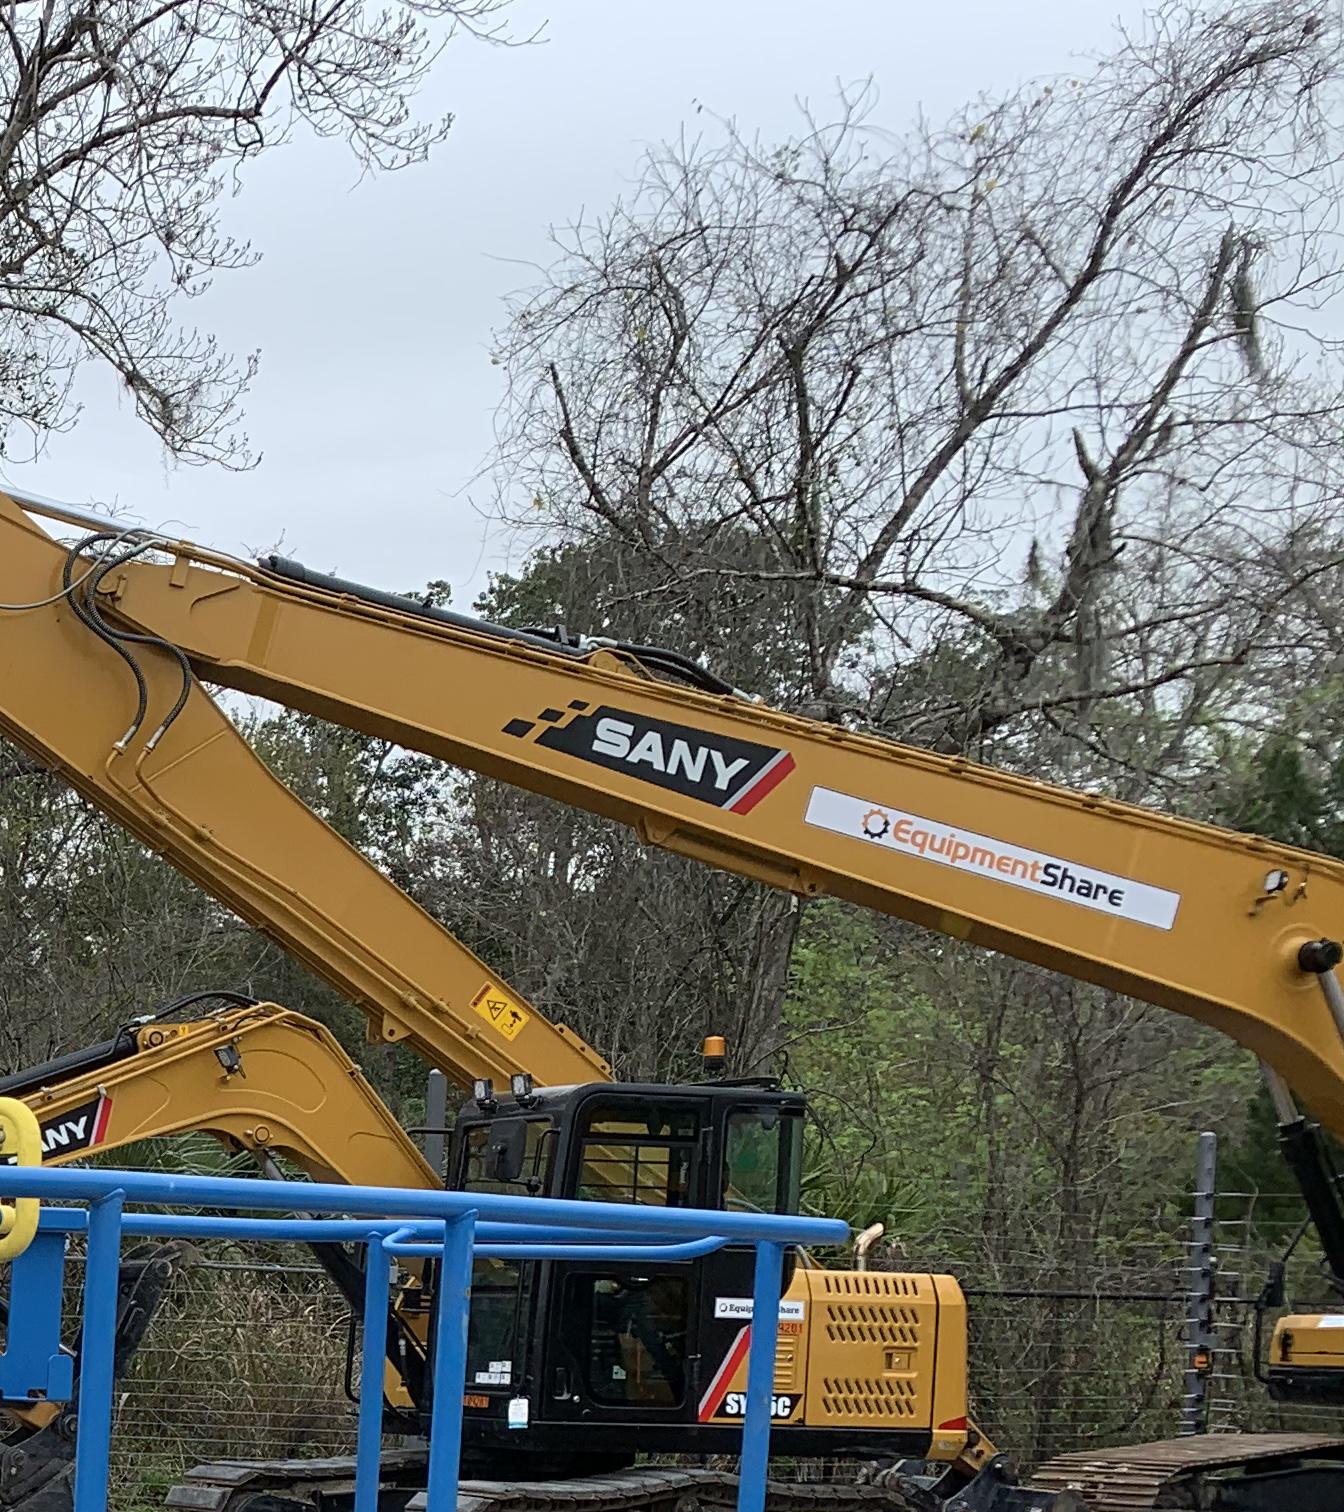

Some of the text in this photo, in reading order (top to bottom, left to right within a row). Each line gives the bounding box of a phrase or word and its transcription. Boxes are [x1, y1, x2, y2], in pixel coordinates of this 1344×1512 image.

[591, 716, 751, 791] SANY
[892, 817, 1126, 910] EquipmentShare
[729, 1304, 800, 1315] Equiphare
